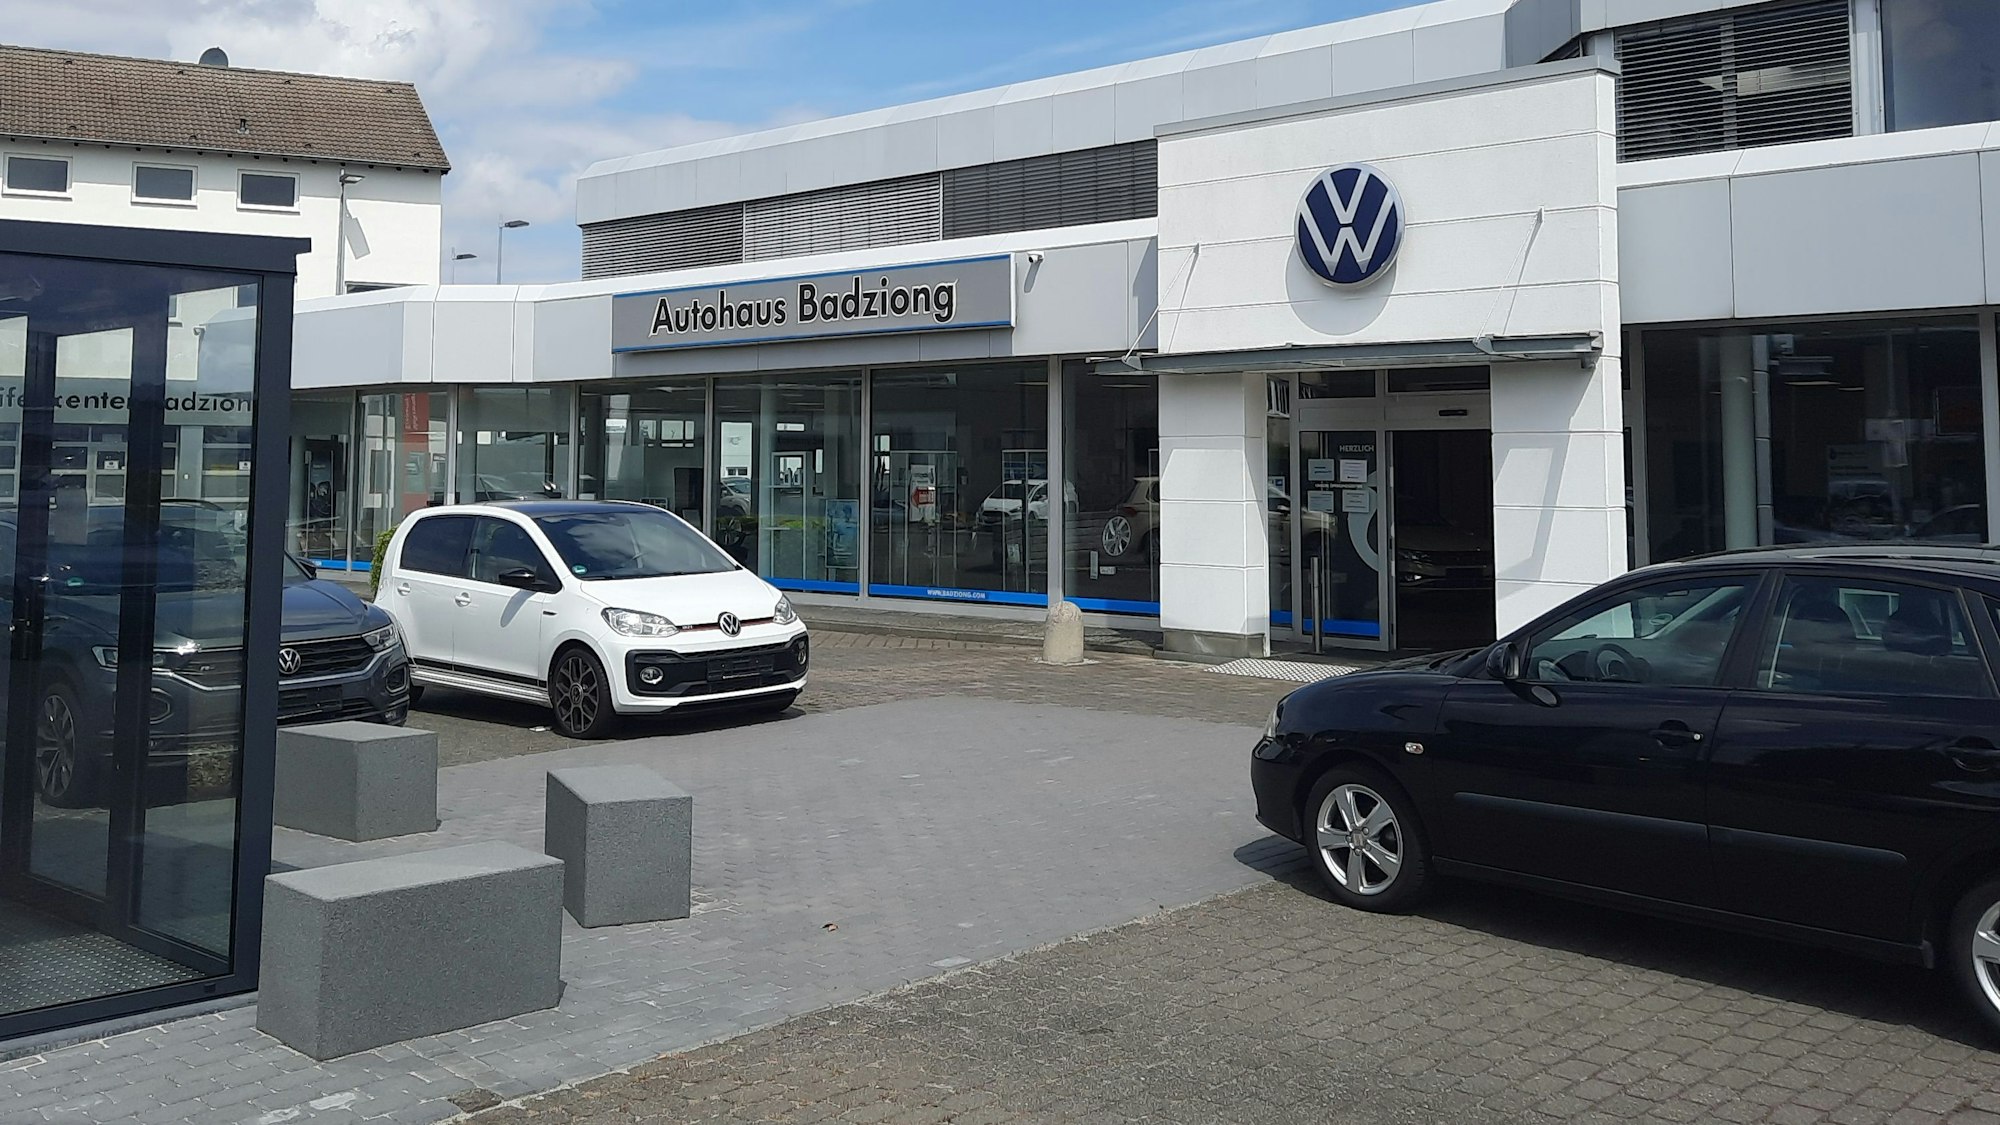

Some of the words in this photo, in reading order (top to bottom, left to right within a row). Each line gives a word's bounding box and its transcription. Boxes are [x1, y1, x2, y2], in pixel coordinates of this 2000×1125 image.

[1298, 165, 1399, 277] VW
[649, 289, 787, 337] Autohaus
[798, 275, 959, 324] Badziong
